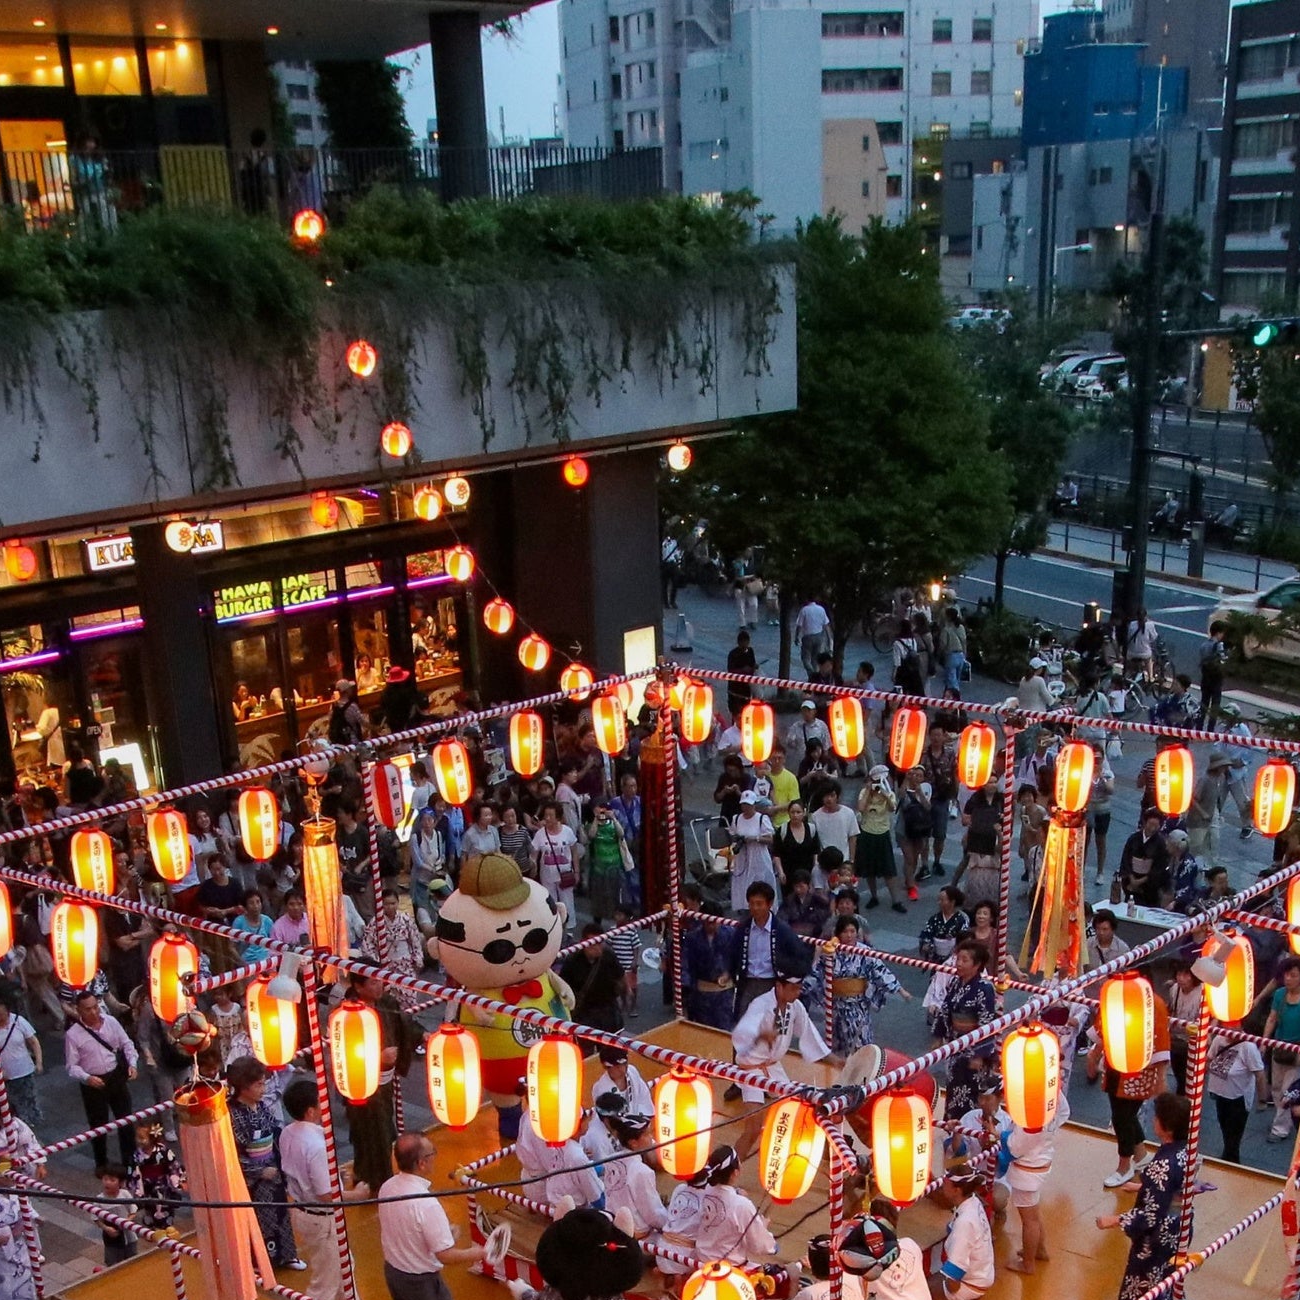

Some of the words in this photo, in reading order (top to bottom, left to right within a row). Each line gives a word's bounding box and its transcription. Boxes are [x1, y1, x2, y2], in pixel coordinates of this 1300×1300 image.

[215, 594, 273, 620] BURGER
[660, 1102, 672, 1162] 墨田区
[915, 1115, 927, 1184] 墨田区
